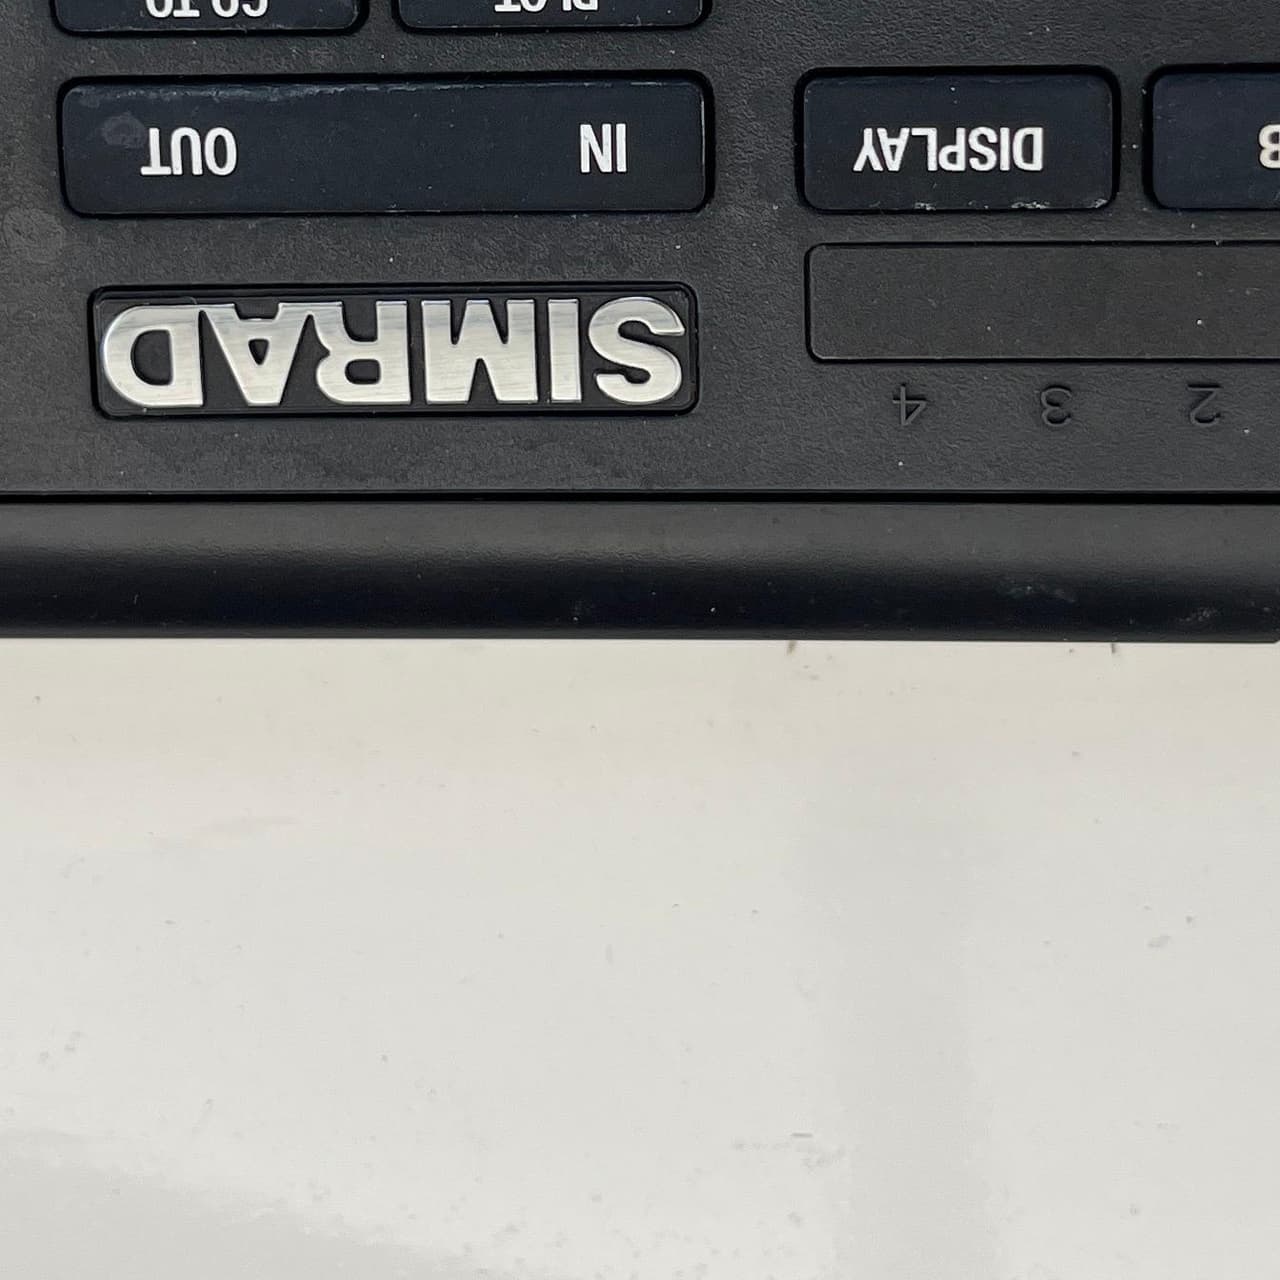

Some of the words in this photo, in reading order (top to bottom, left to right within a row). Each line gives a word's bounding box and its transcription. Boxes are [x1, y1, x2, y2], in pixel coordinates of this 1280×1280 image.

[140, 126, 237, 176] OUT
[579, 123, 627, 173] IN
[853, 126, 1044, 172] DISPLAY
[100, 296, 685, 408] SIMRAD
[891, 384, 928, 427] 4
[1040, 384, 1073, 427] 3
[1186, 384, 1221, 427] 2
